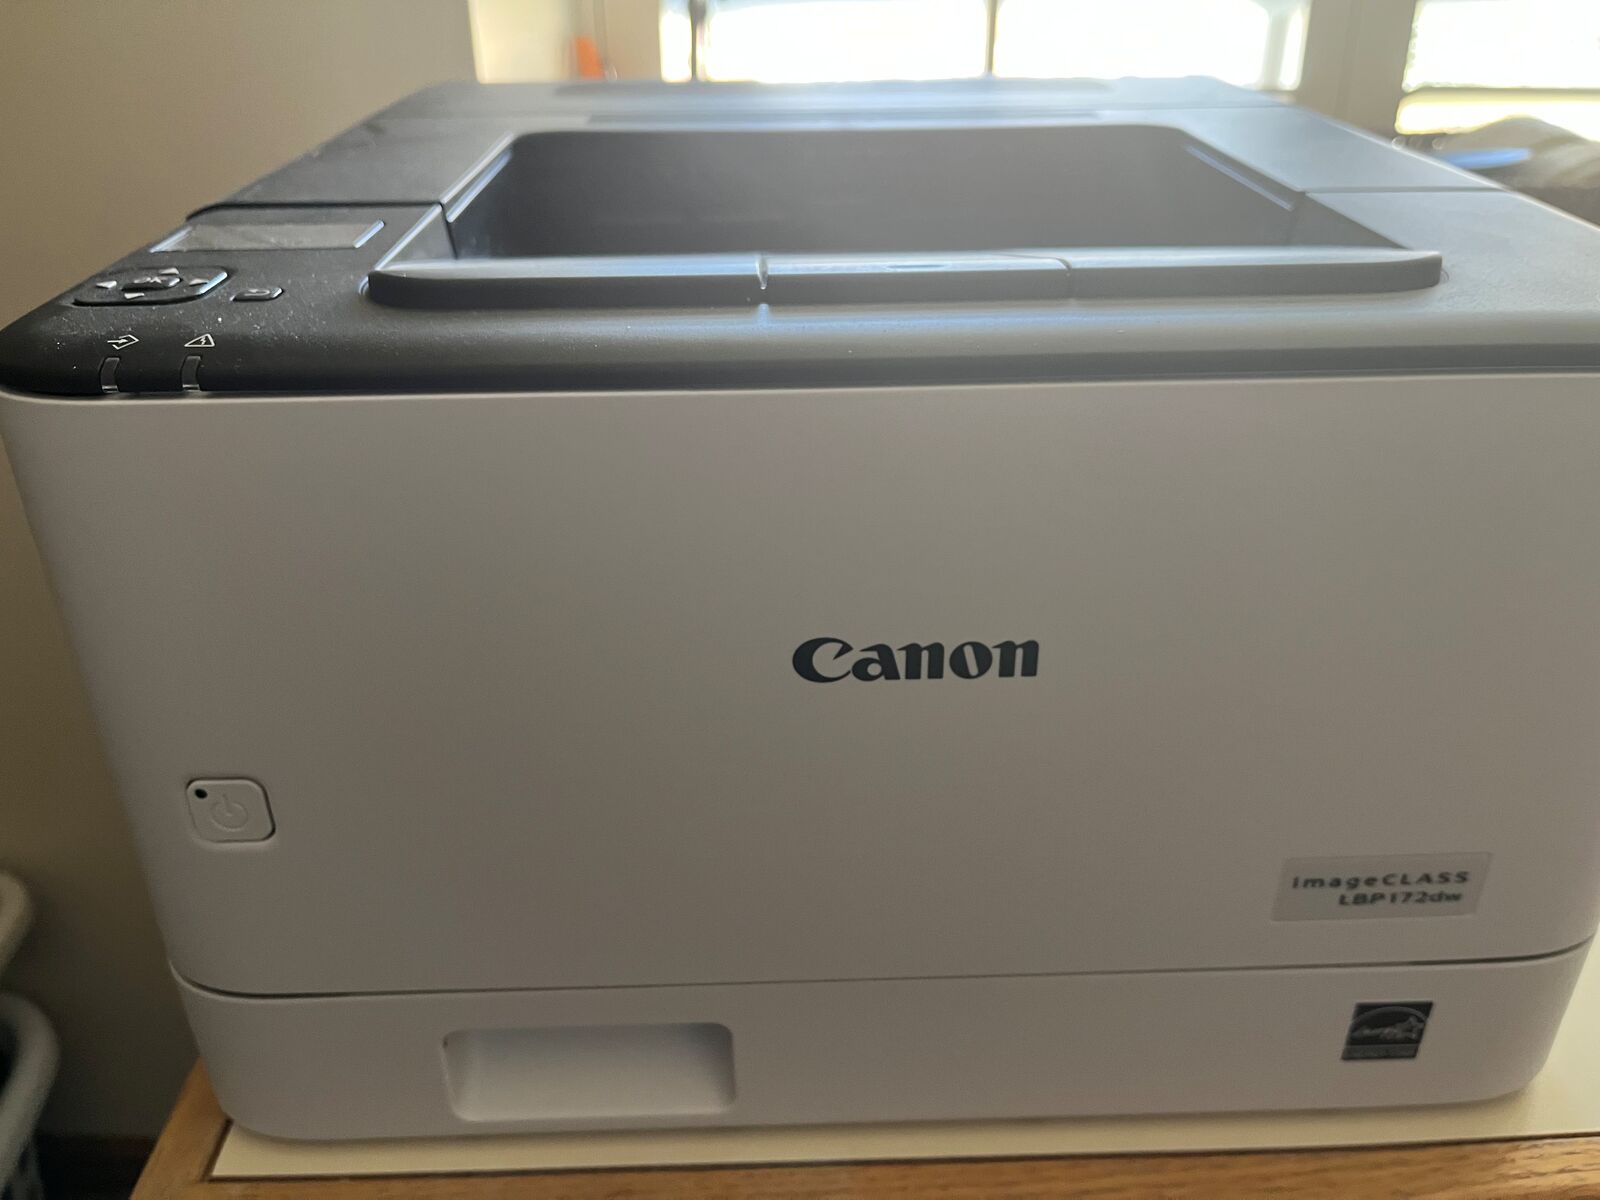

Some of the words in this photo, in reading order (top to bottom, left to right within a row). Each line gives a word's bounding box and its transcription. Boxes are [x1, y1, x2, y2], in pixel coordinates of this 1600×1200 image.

[792, 637, 1039, 683] Canon
[1292, 871, 1469, 890] imageCLASS
[1338, 890, 1463, 906] LBP172dw
